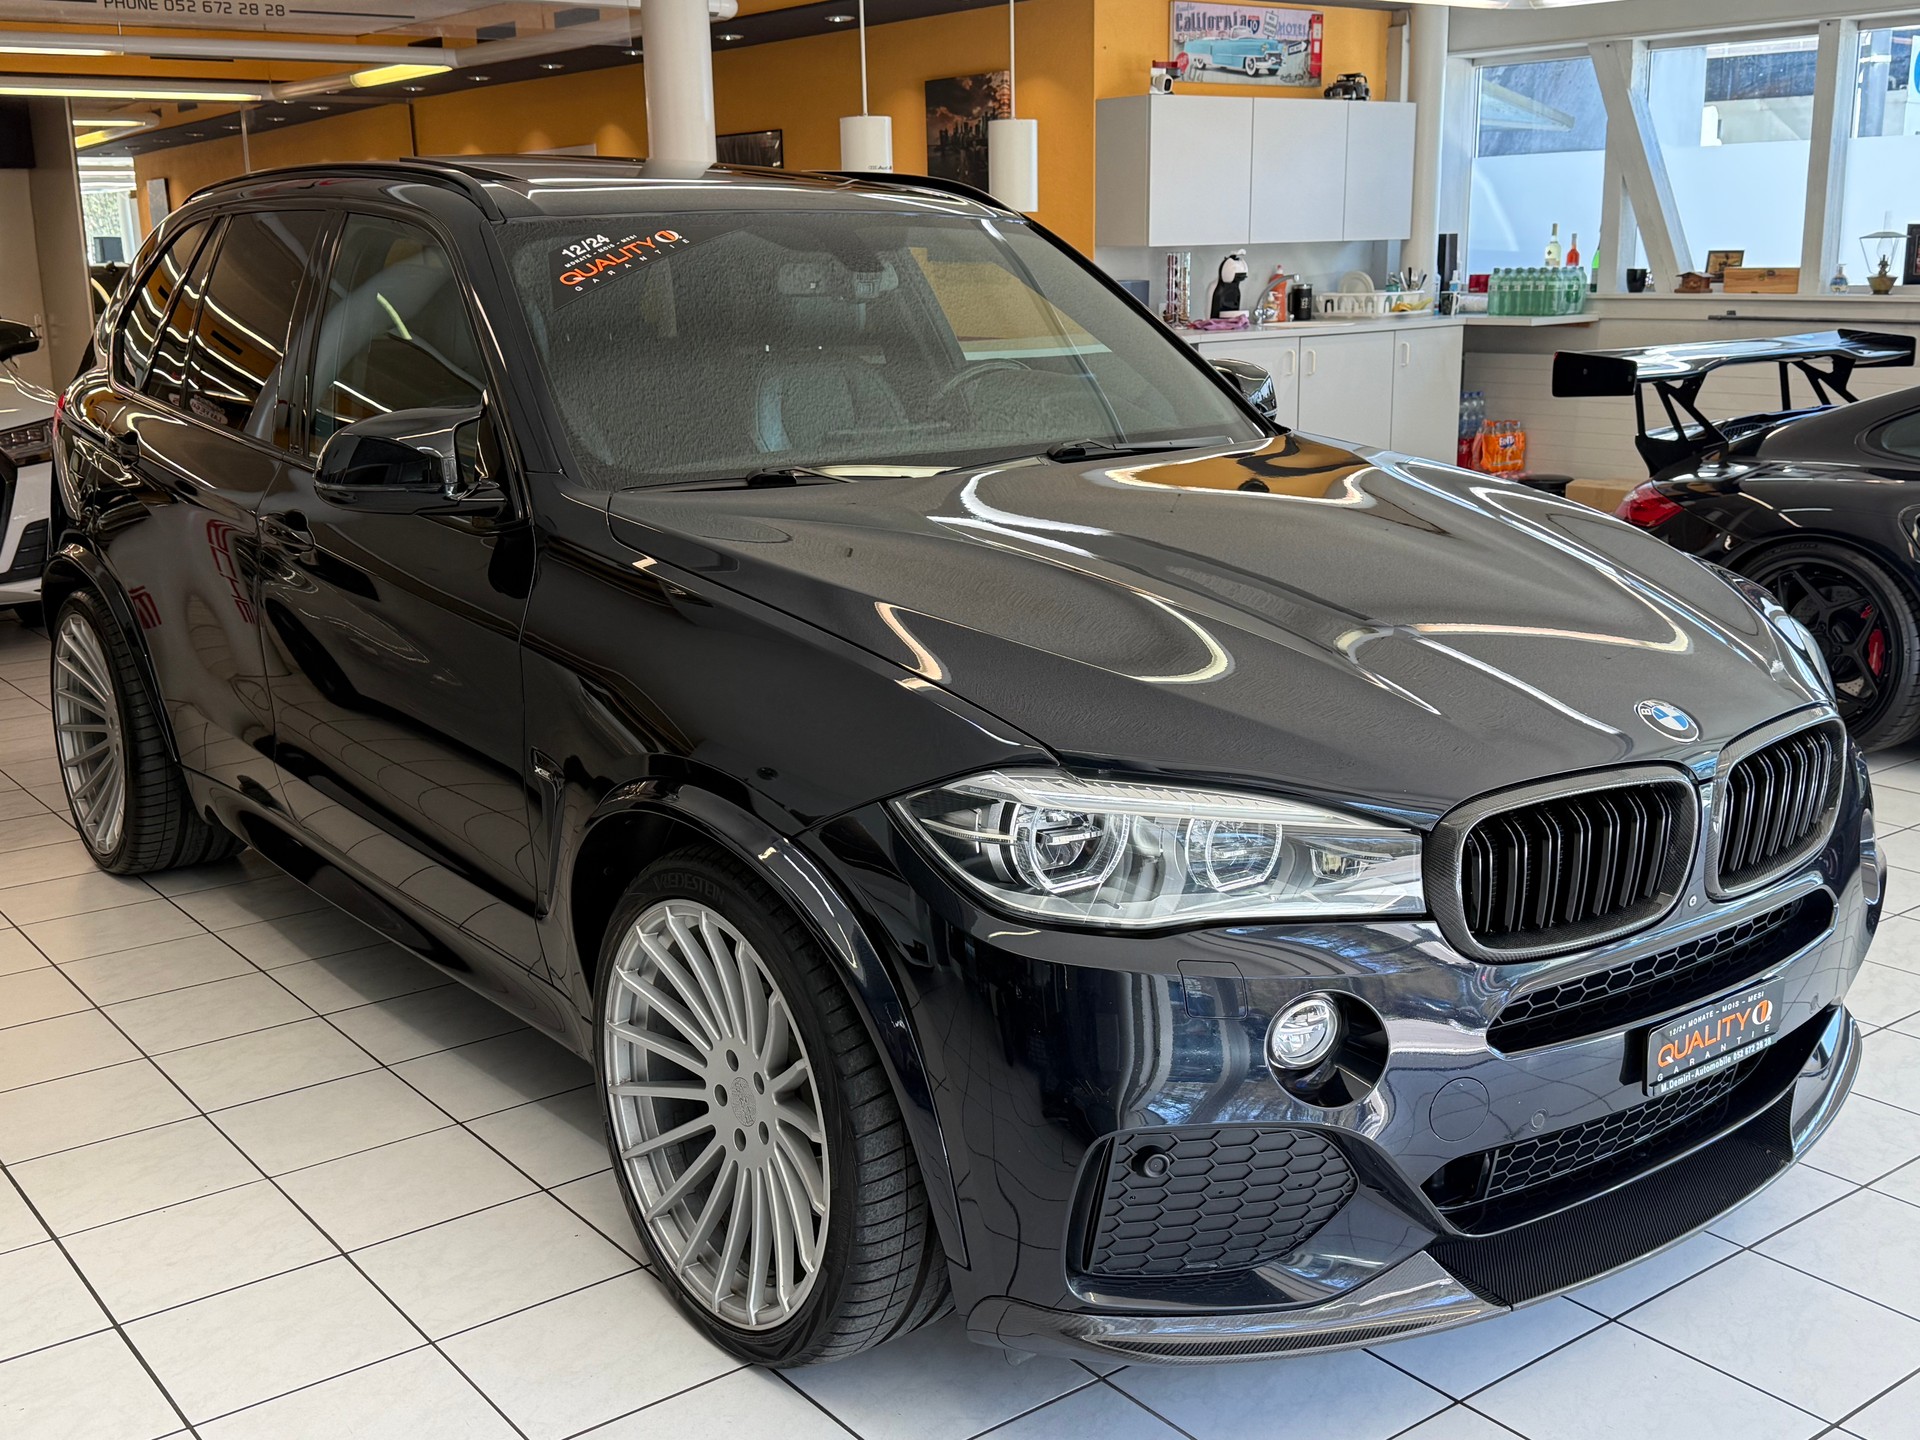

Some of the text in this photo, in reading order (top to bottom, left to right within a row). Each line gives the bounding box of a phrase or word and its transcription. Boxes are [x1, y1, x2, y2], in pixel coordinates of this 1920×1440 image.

[104, 0, 286, 17] PHONE 052 672 28 28
[1176, 11, 1247, 32] California
[1277, 22, 1308, 36] MOTEL
[561, 234, 610, 258] 12/24
[564, 253, 592, 268] MONATE
[597, 244, 615, 253] MOIS
[559, 236, 656, 285] QUALITY
[1669, 991, 1765, 1036] 12/24 MONATE MOIS MESI
[1657, 1007, 1752, 1068] QUALITY
[1657, 1024, 1770, 1082] GARANTIE
